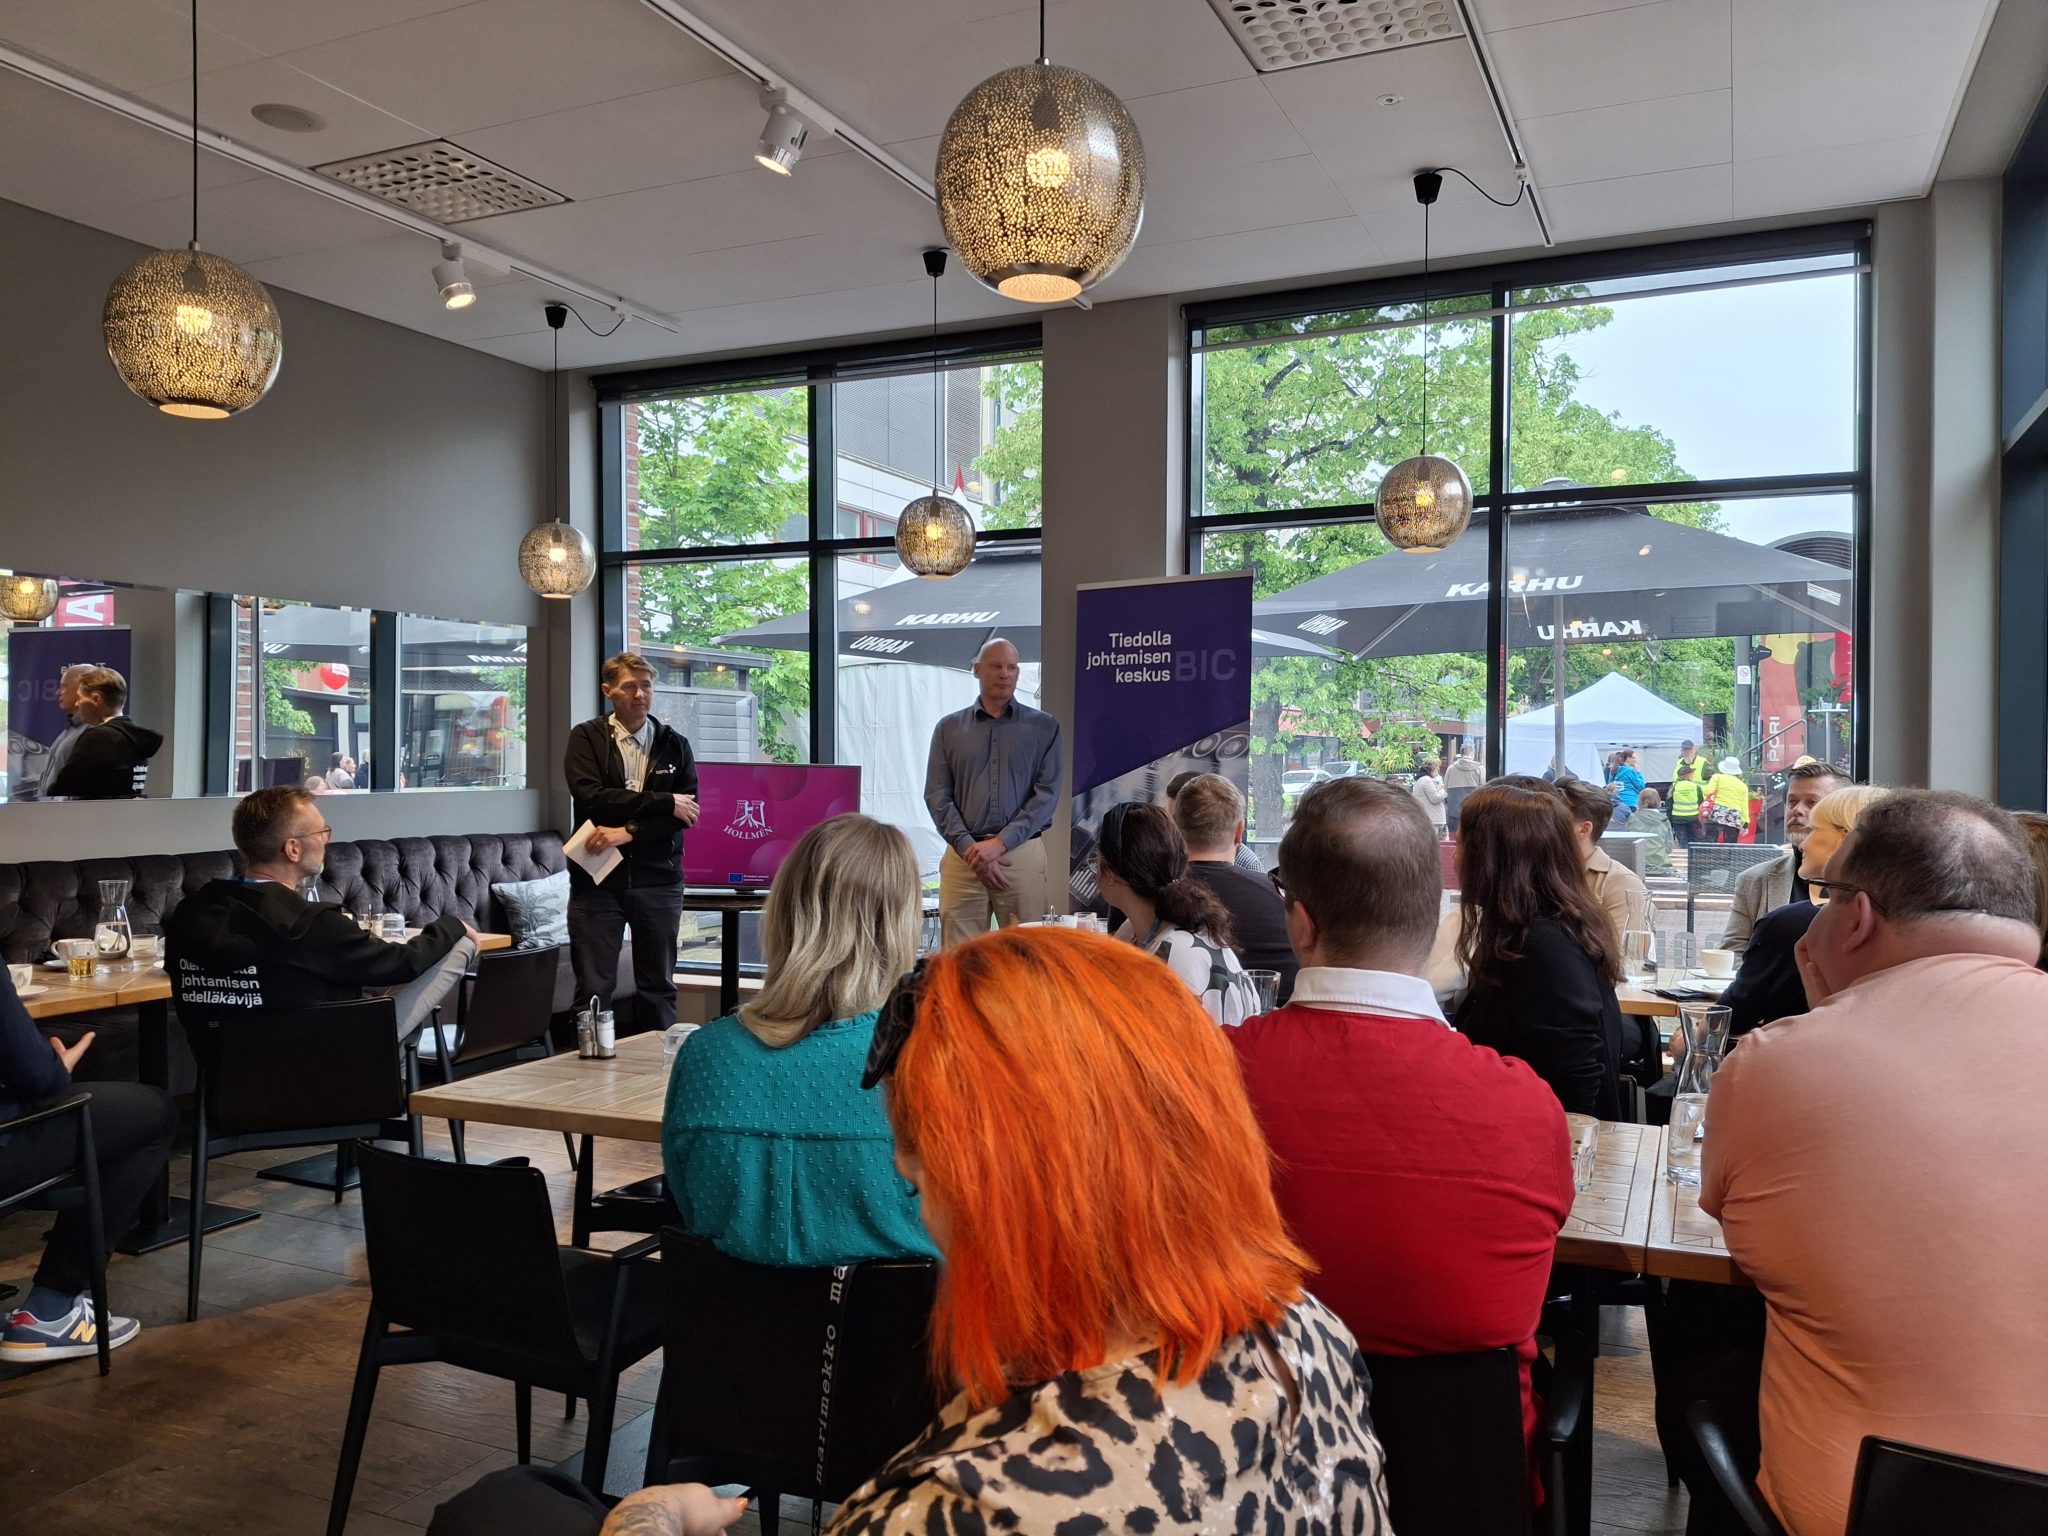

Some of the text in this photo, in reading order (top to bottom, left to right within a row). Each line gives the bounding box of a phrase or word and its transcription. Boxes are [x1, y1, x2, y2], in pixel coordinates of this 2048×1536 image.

[895, 611, 1000, 626] KARHU
[1109, 631, 1172, 648] Tiedolla
[1086, 650, 1171, 671] johtamisen
[1175, 649, 1236, 682] BIC
[1116, 667, 1171, 683] keskus
[1769, 716, 1780, 762] PORI
[181, 974, 260, 989] johtamisen
[182, 990, 263, 1008] edelläkävijä
[816, 1324, 837, 1486] marimekko
